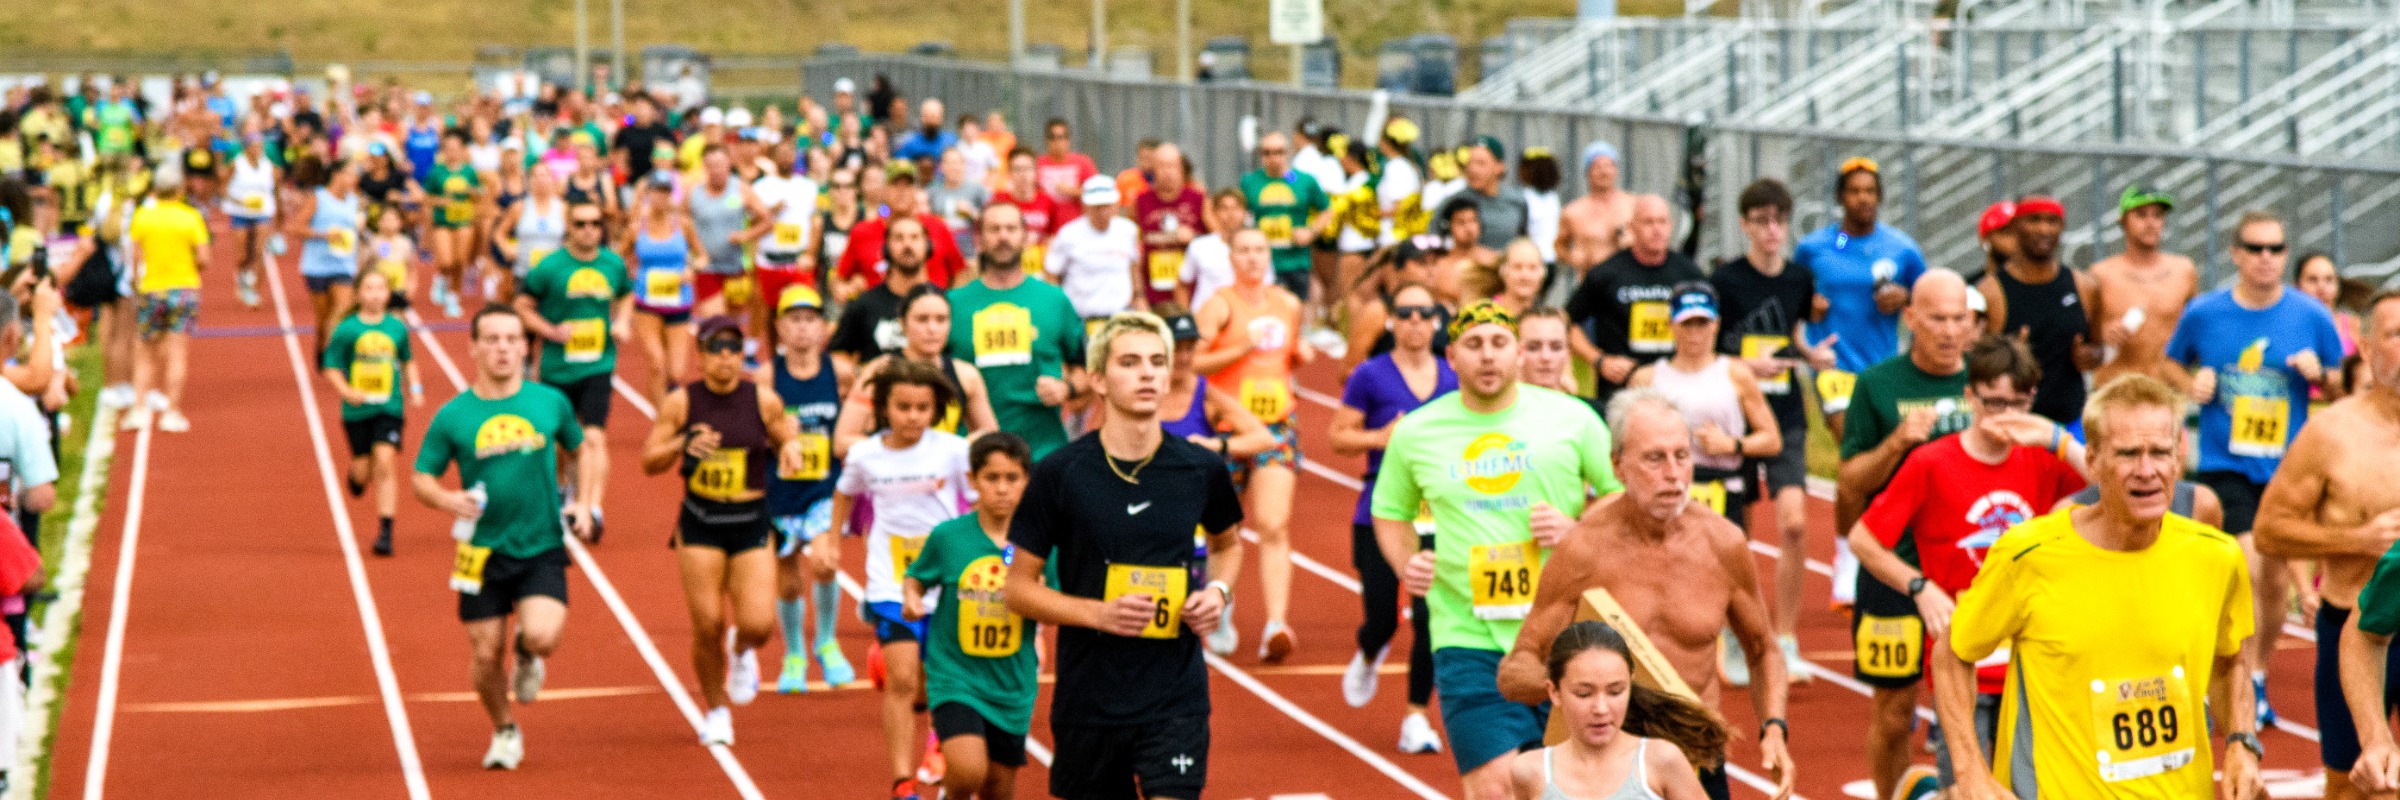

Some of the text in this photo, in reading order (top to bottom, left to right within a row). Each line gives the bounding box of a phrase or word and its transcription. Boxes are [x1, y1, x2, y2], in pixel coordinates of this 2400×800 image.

[1483, 566, 1533, 599] 748
[972, 623, 1013, 649] 102
[1868, 640, 1909, 668] 210
[2112, 704, 2178, 751] 689
